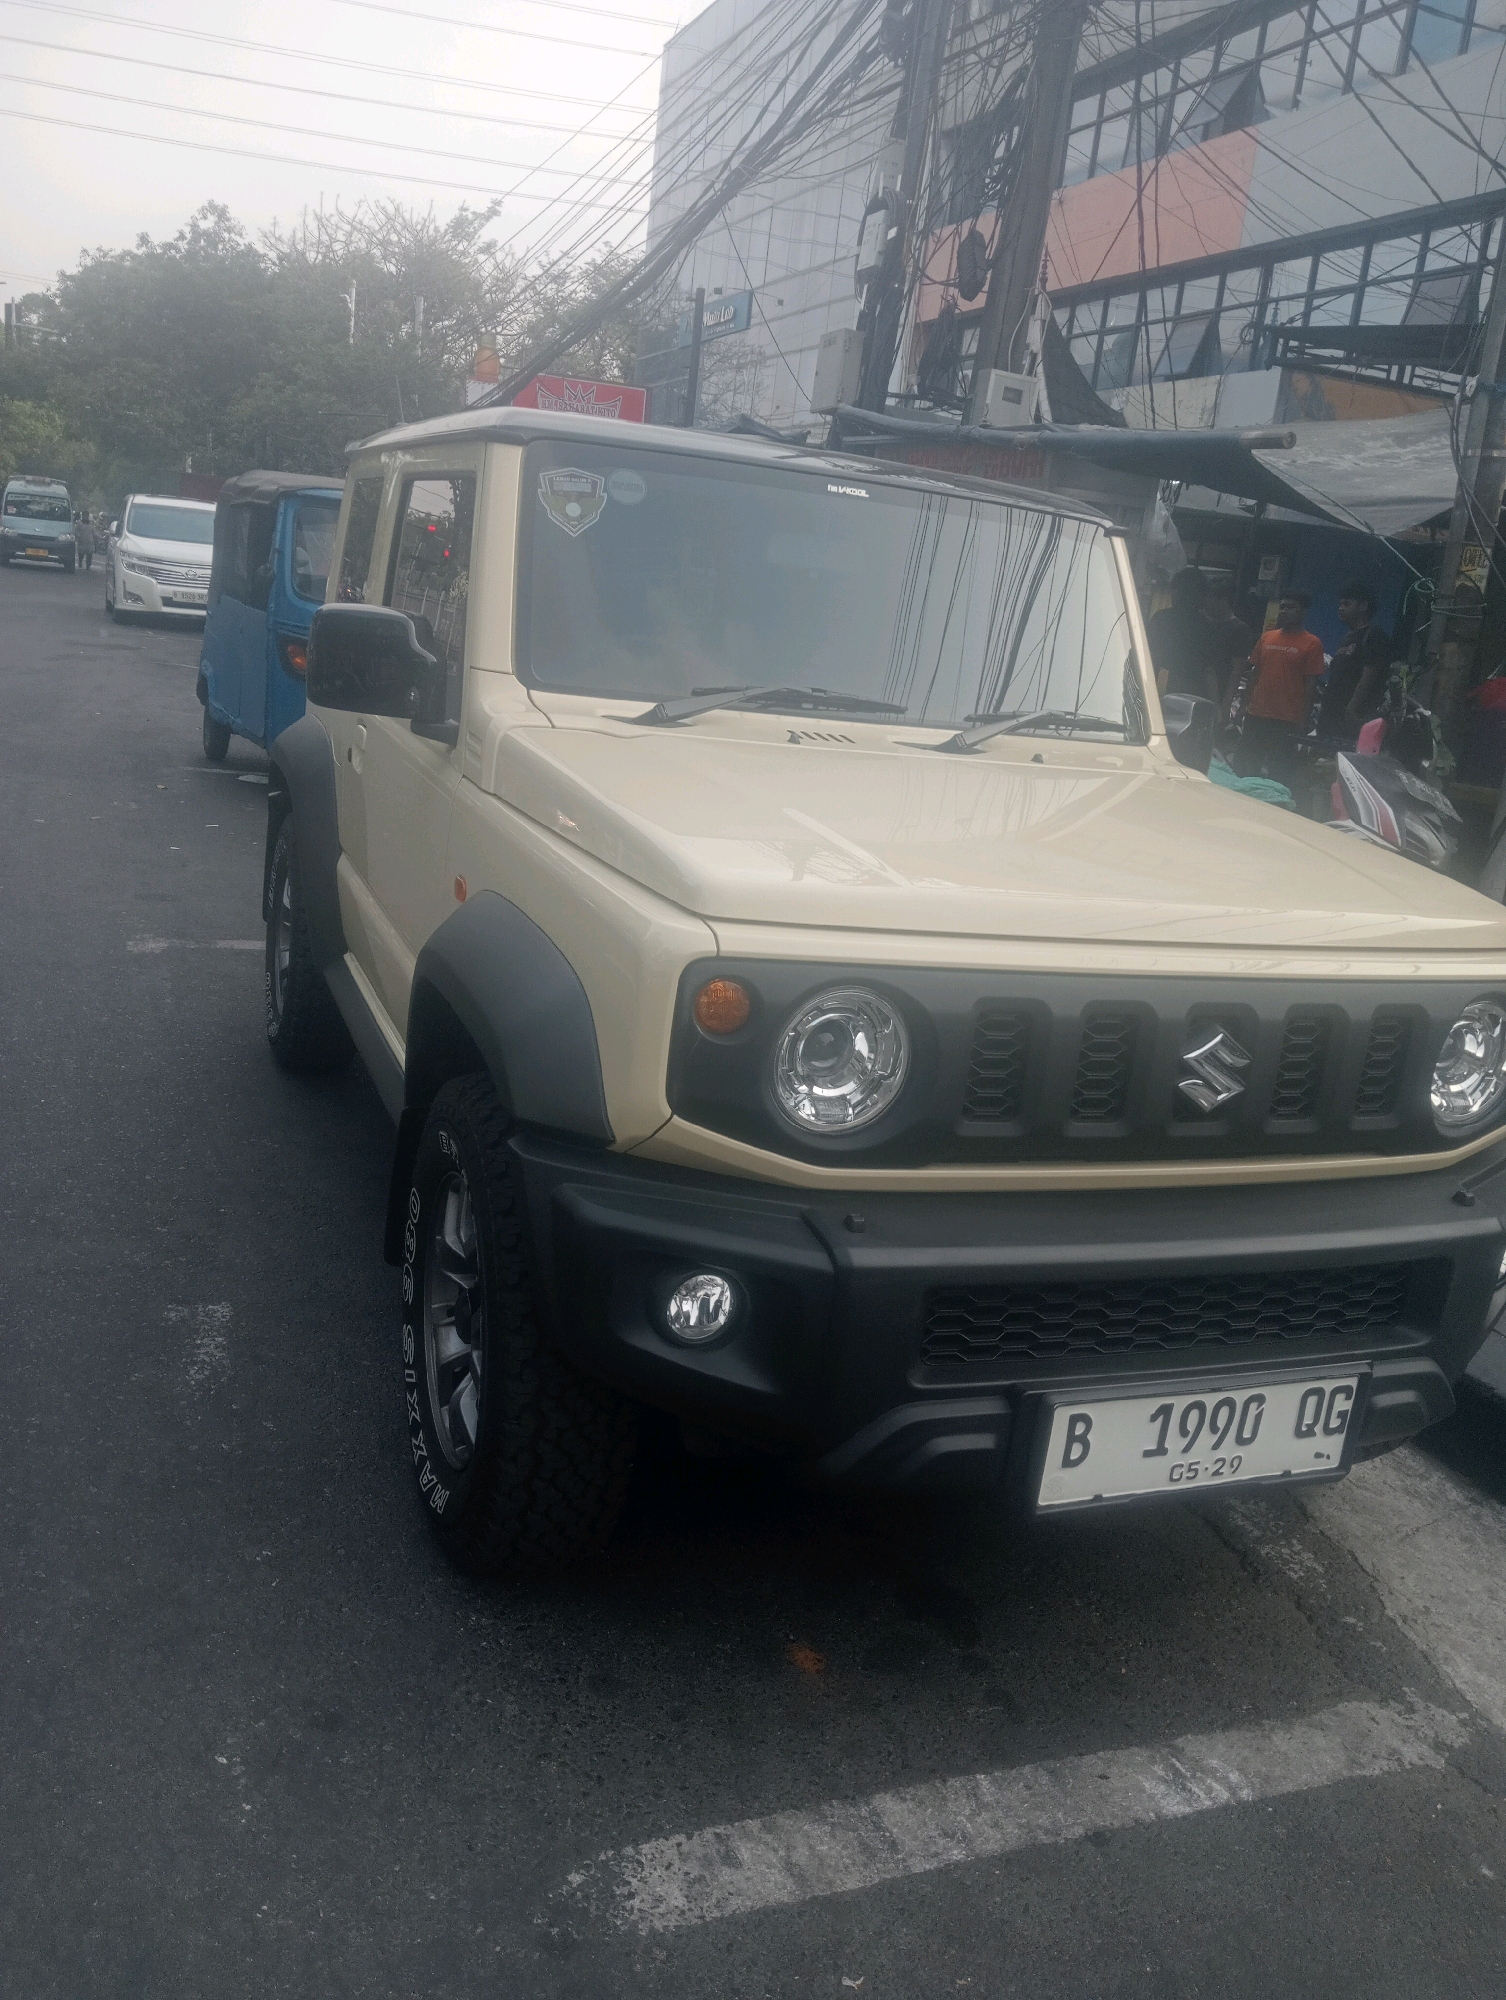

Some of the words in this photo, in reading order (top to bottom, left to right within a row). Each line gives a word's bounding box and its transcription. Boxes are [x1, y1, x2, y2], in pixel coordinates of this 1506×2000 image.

[403, 1324, 450, 1514] MAXXIS
[1061, 1412, 1093, 1468] B
[1143, 1392, 1267, 1458] 1990
[1294, 1384, 1354, 1439] QG
